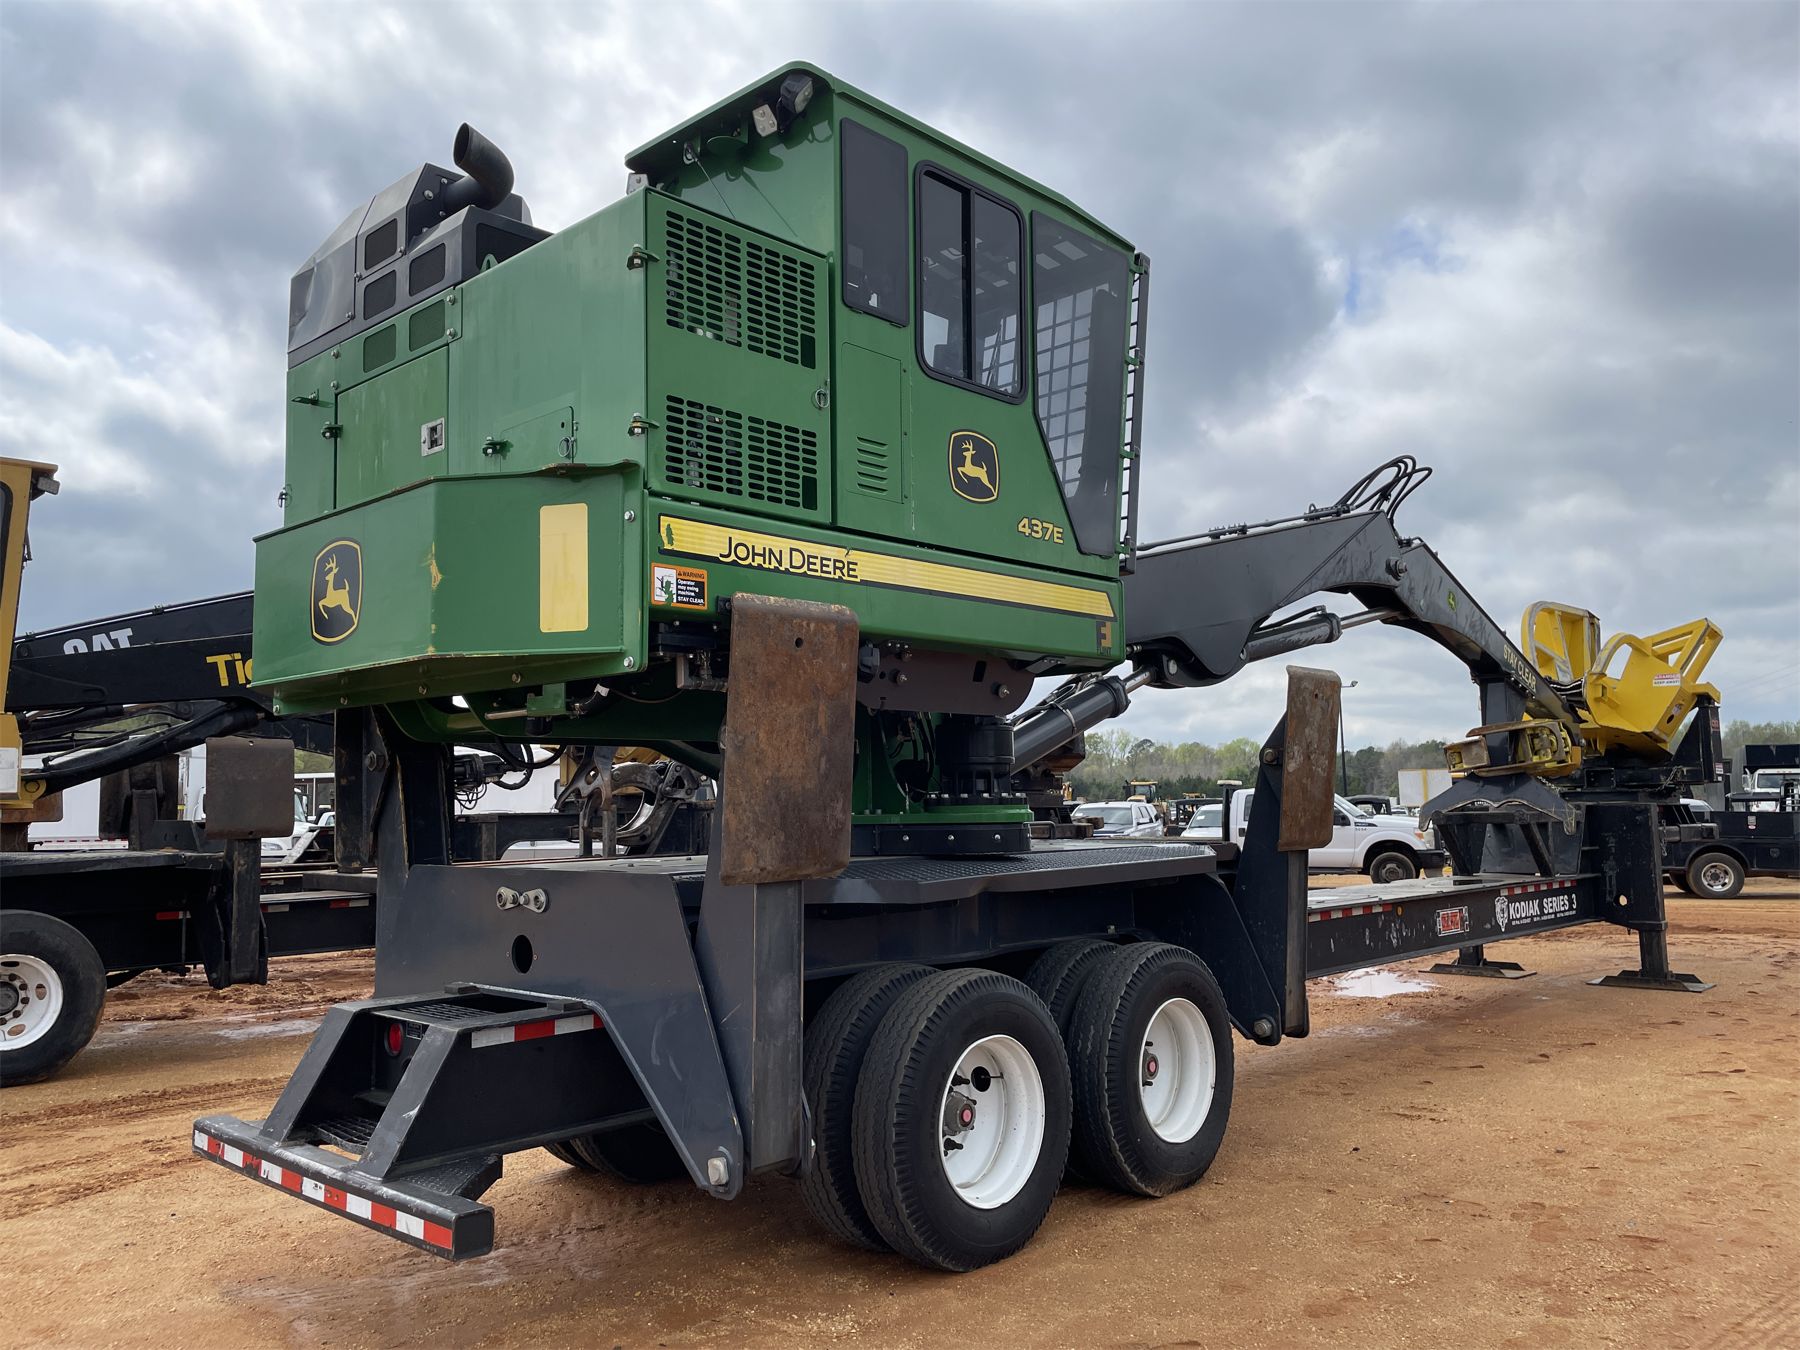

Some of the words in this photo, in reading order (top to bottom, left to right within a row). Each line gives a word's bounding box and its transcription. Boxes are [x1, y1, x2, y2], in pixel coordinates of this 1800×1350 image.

[1018, 517, 1064, 544] 437E
[719, 537, 783, 567] JOHN
[789, 547, 859, 579] DEERE
[682, 571, 704, 579] WARNING
[1503, 644, 1518, 670] STAY
[1518, 660, 1537, 694] CLEAR
[1508, 899, 1540, 919] KODIAK
[1543, 894, 1569, 914] SERIES
[1571, 893, 1577, 909] 3
